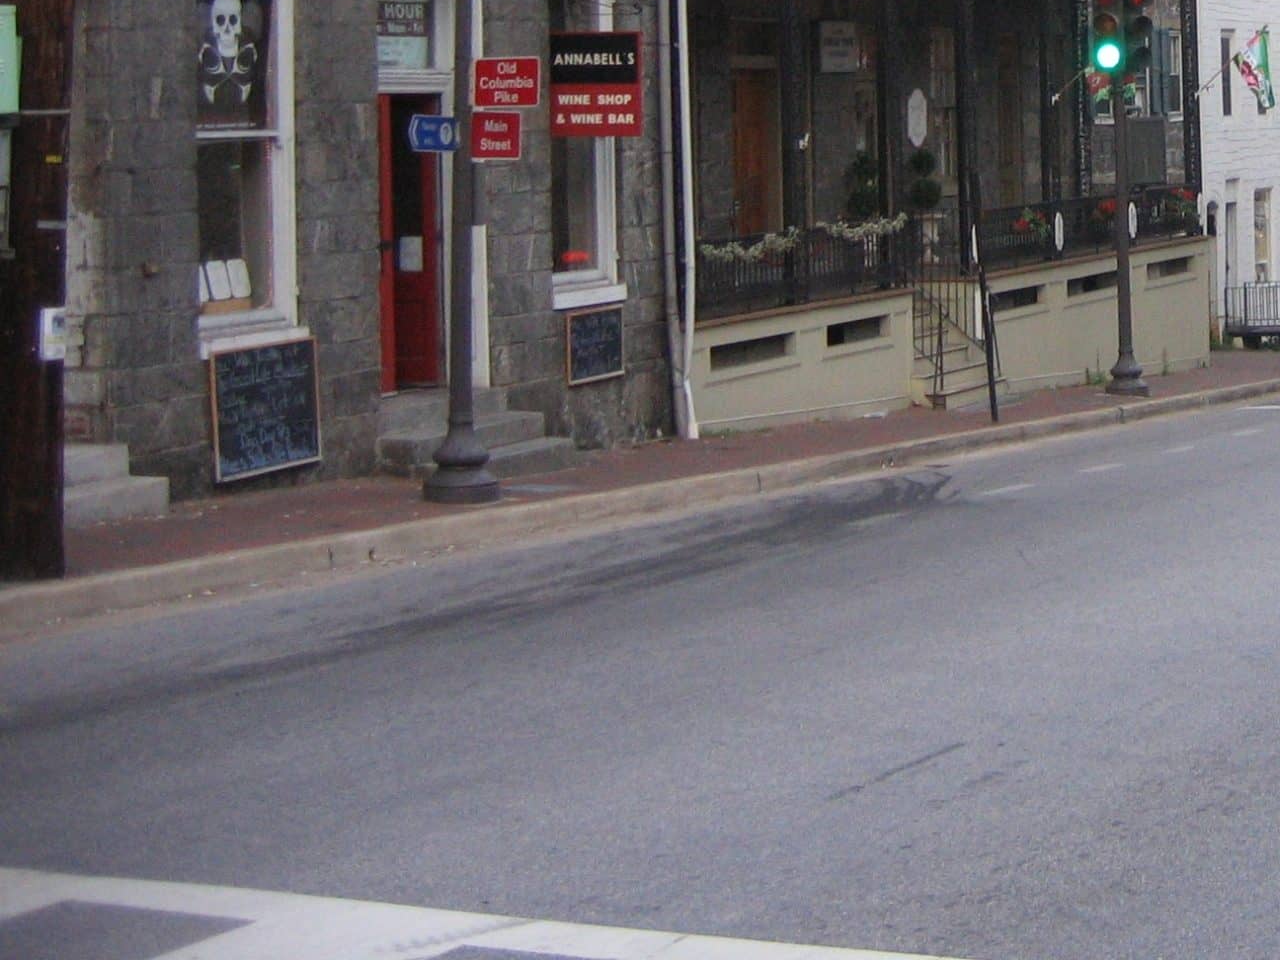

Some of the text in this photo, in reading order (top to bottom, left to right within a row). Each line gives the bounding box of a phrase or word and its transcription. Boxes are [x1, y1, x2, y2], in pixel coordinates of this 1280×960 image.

[554, 52, 634, 65] ANNABELL'S
[497, 62, 517, 74] Old
[480, 76, 534, 88] Columbia
[494, 91, 518, 103] Pike
[558, 94, 632, 105] WINE SHOP
[556, 113, 634, 124] & WINE BAR
[484, 120, 508, 132] Main
[480, 138, 511, 150] Street
